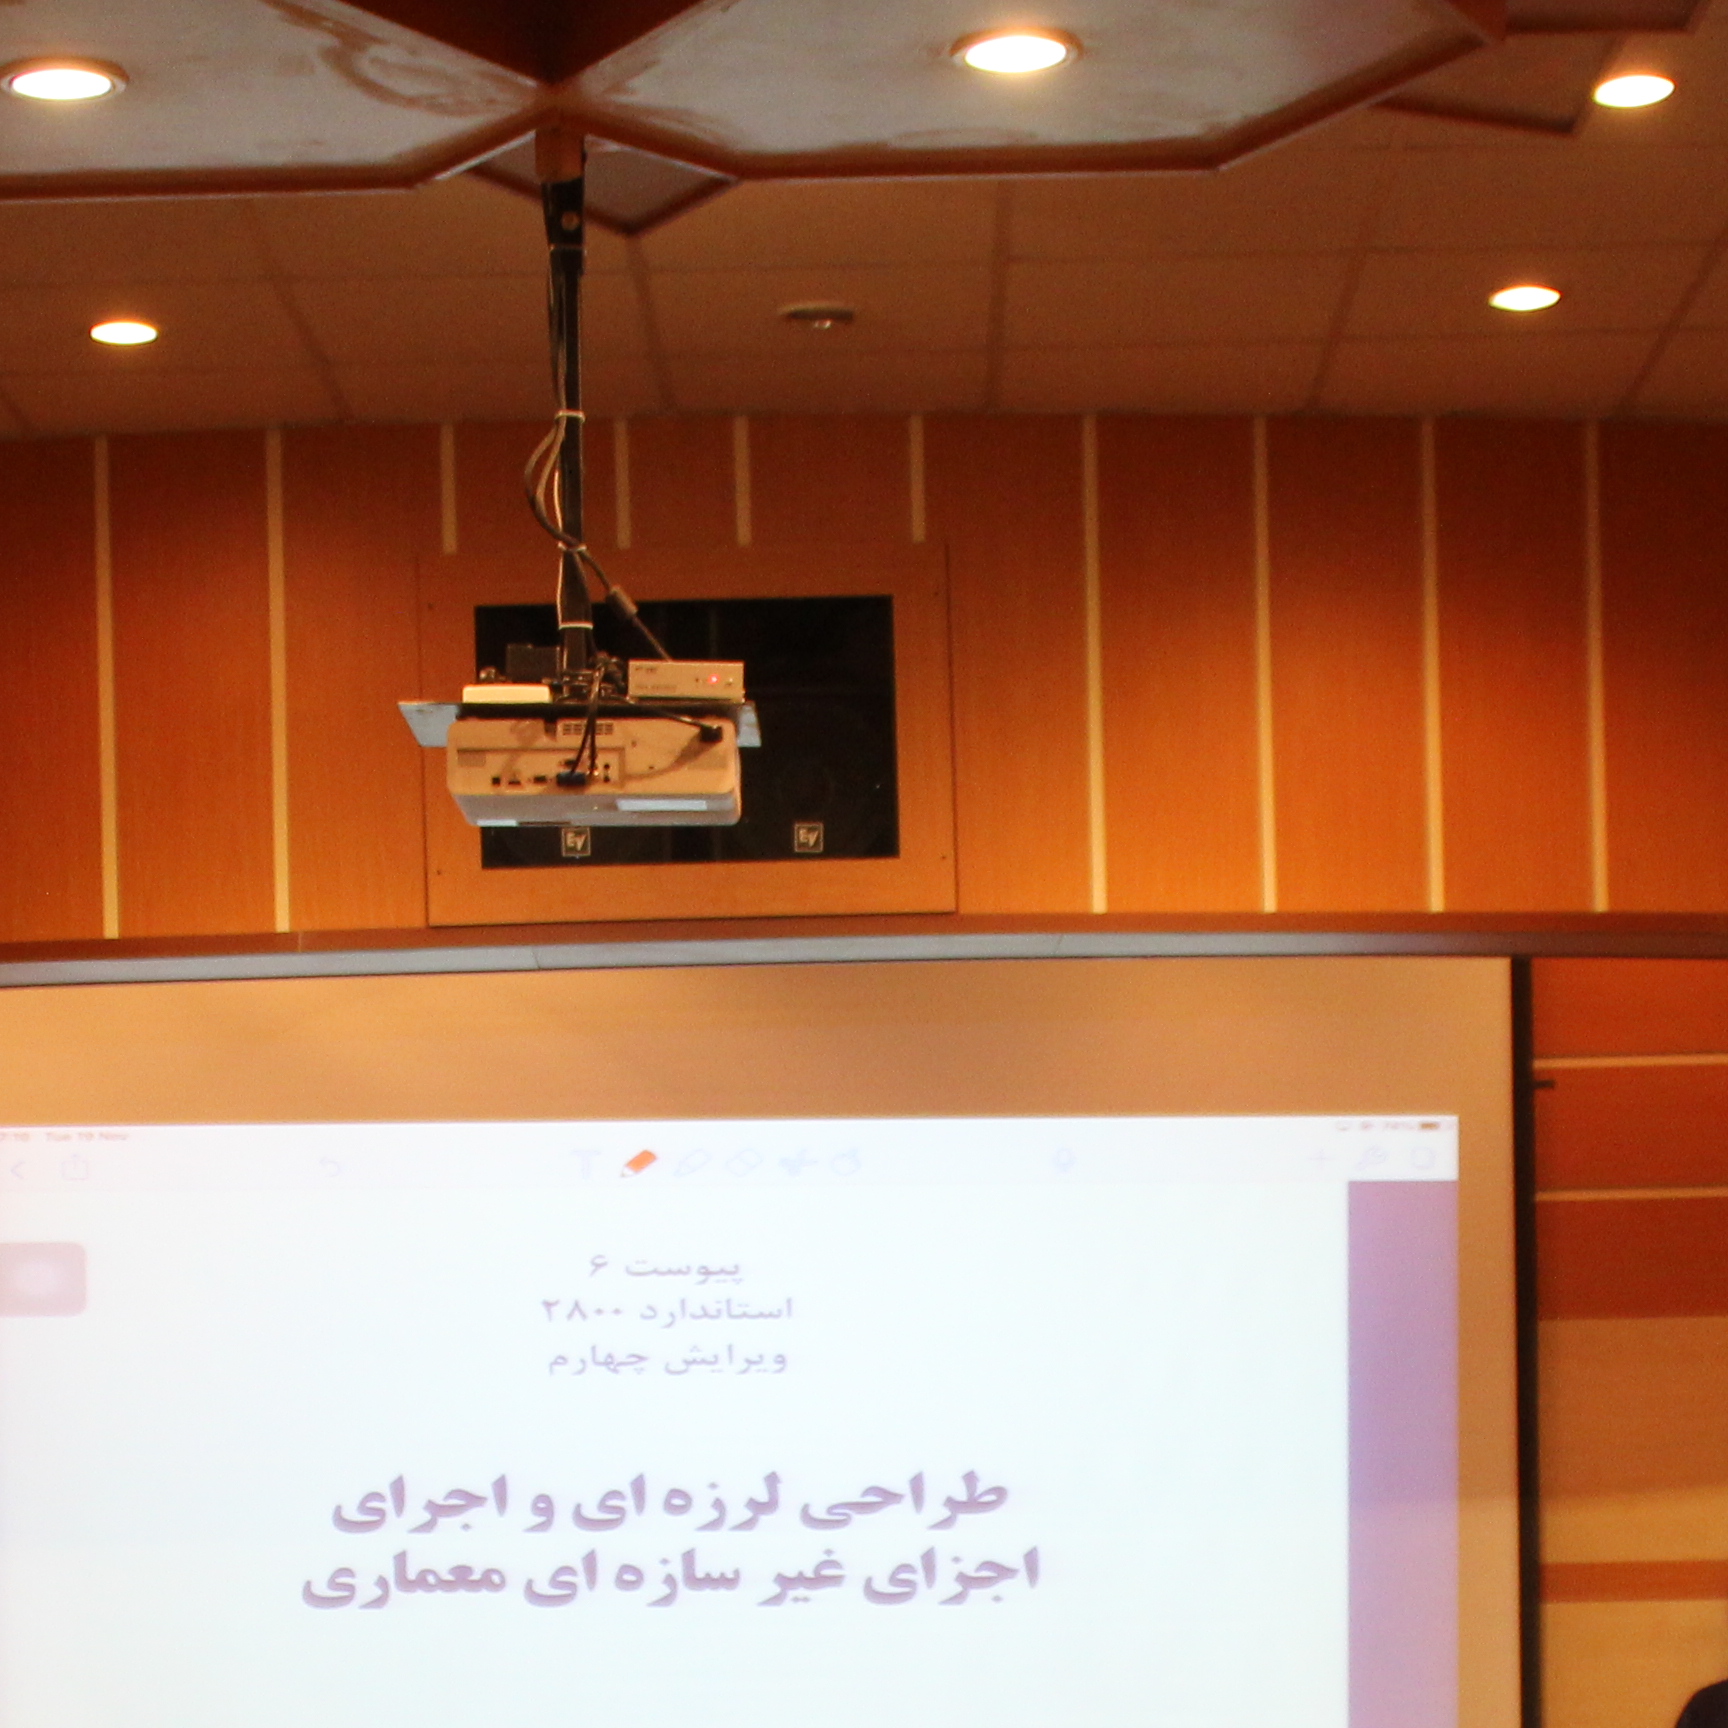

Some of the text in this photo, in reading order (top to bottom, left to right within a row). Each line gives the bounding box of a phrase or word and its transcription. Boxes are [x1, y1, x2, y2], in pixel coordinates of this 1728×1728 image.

[624, 1258, 744, 1285] پیوست
[540, 1296, 793, 1329] استاندارد ۲۸۰۰
[547, 1342, 789, 1376] ویرایش چهارم
[330, 1473, 510, 1533] اجرای
[523, 1490, 556, 1533] و
[798, 1470, 1010, 1531] طراحی
[300, 1549, 508, 1609] معماری
[756, 1546, 847, 1607] غیر
[862, 1545, 1040, 1607] اجزای
